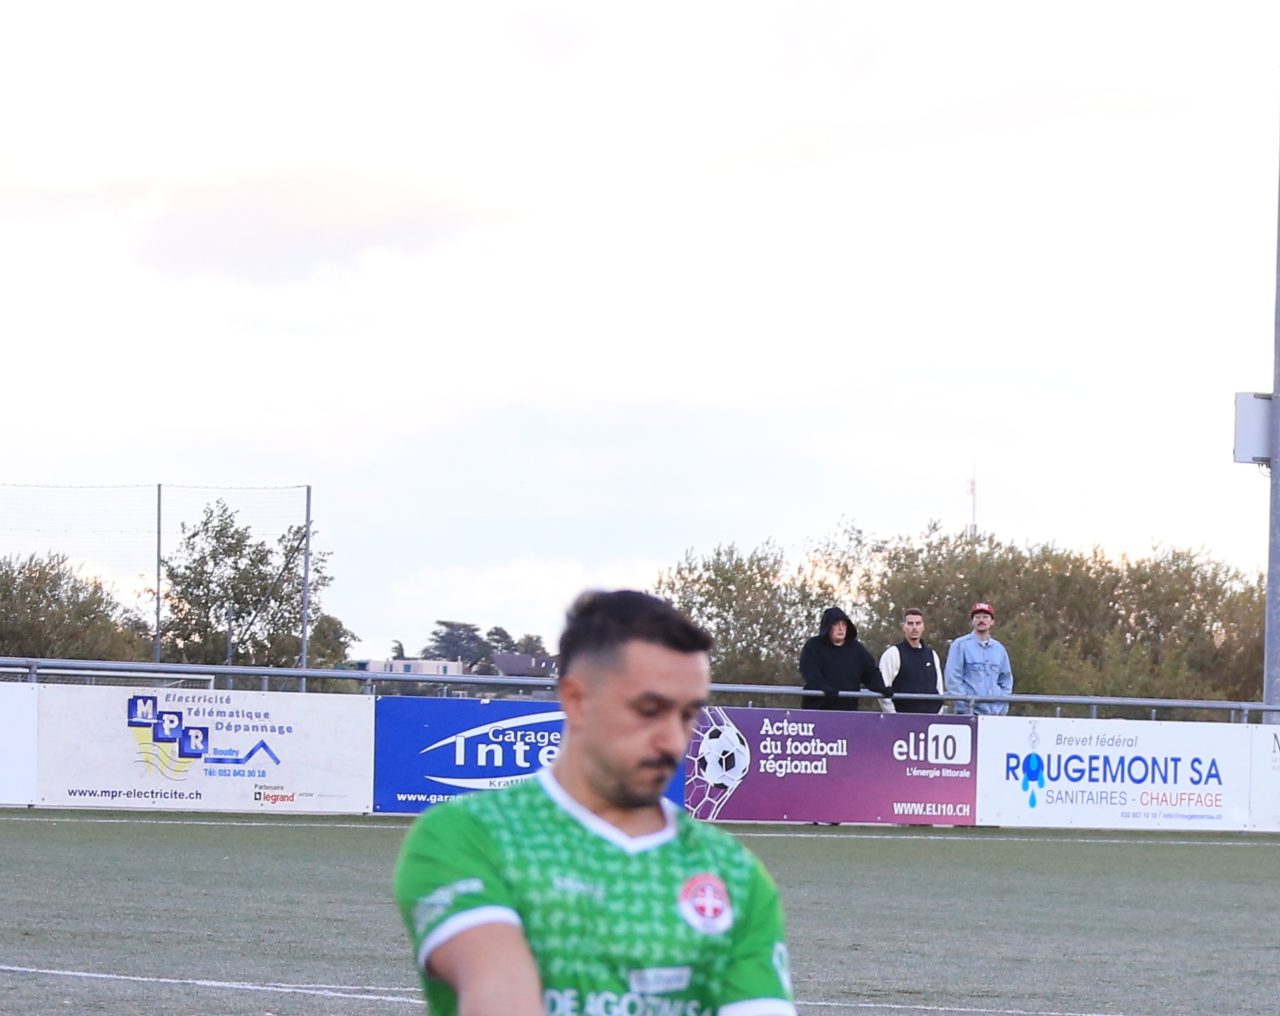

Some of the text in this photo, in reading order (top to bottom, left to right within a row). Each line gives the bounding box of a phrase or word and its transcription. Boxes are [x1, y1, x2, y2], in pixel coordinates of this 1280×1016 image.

[165, 693, 232, 704] Electricité
[187, 707, 271, 719] Télématique
[215, 721, 294, 735] Dépannage
[759, 718, 815, 737] Acteur
[759, 737, 847, 756] du football
[1055, 733, 1139, 748] Brevet fédéral
[759, 755, 828, 777] régional
[906, 767, 970, 778] L'énergie littorale
[1005, 752, 1224, 786] ROUGEMONT SA
[67, 787, 202, 801] www.mpr-electricite.ch
[263, 792, 295, 804] legrand
[1045, 789, 1128, 807] SANITAIRES
[1140, 791, 1224, 808] CHAUFFAGE
[893, 802, 971, 817] WWW.ELI10.CH
